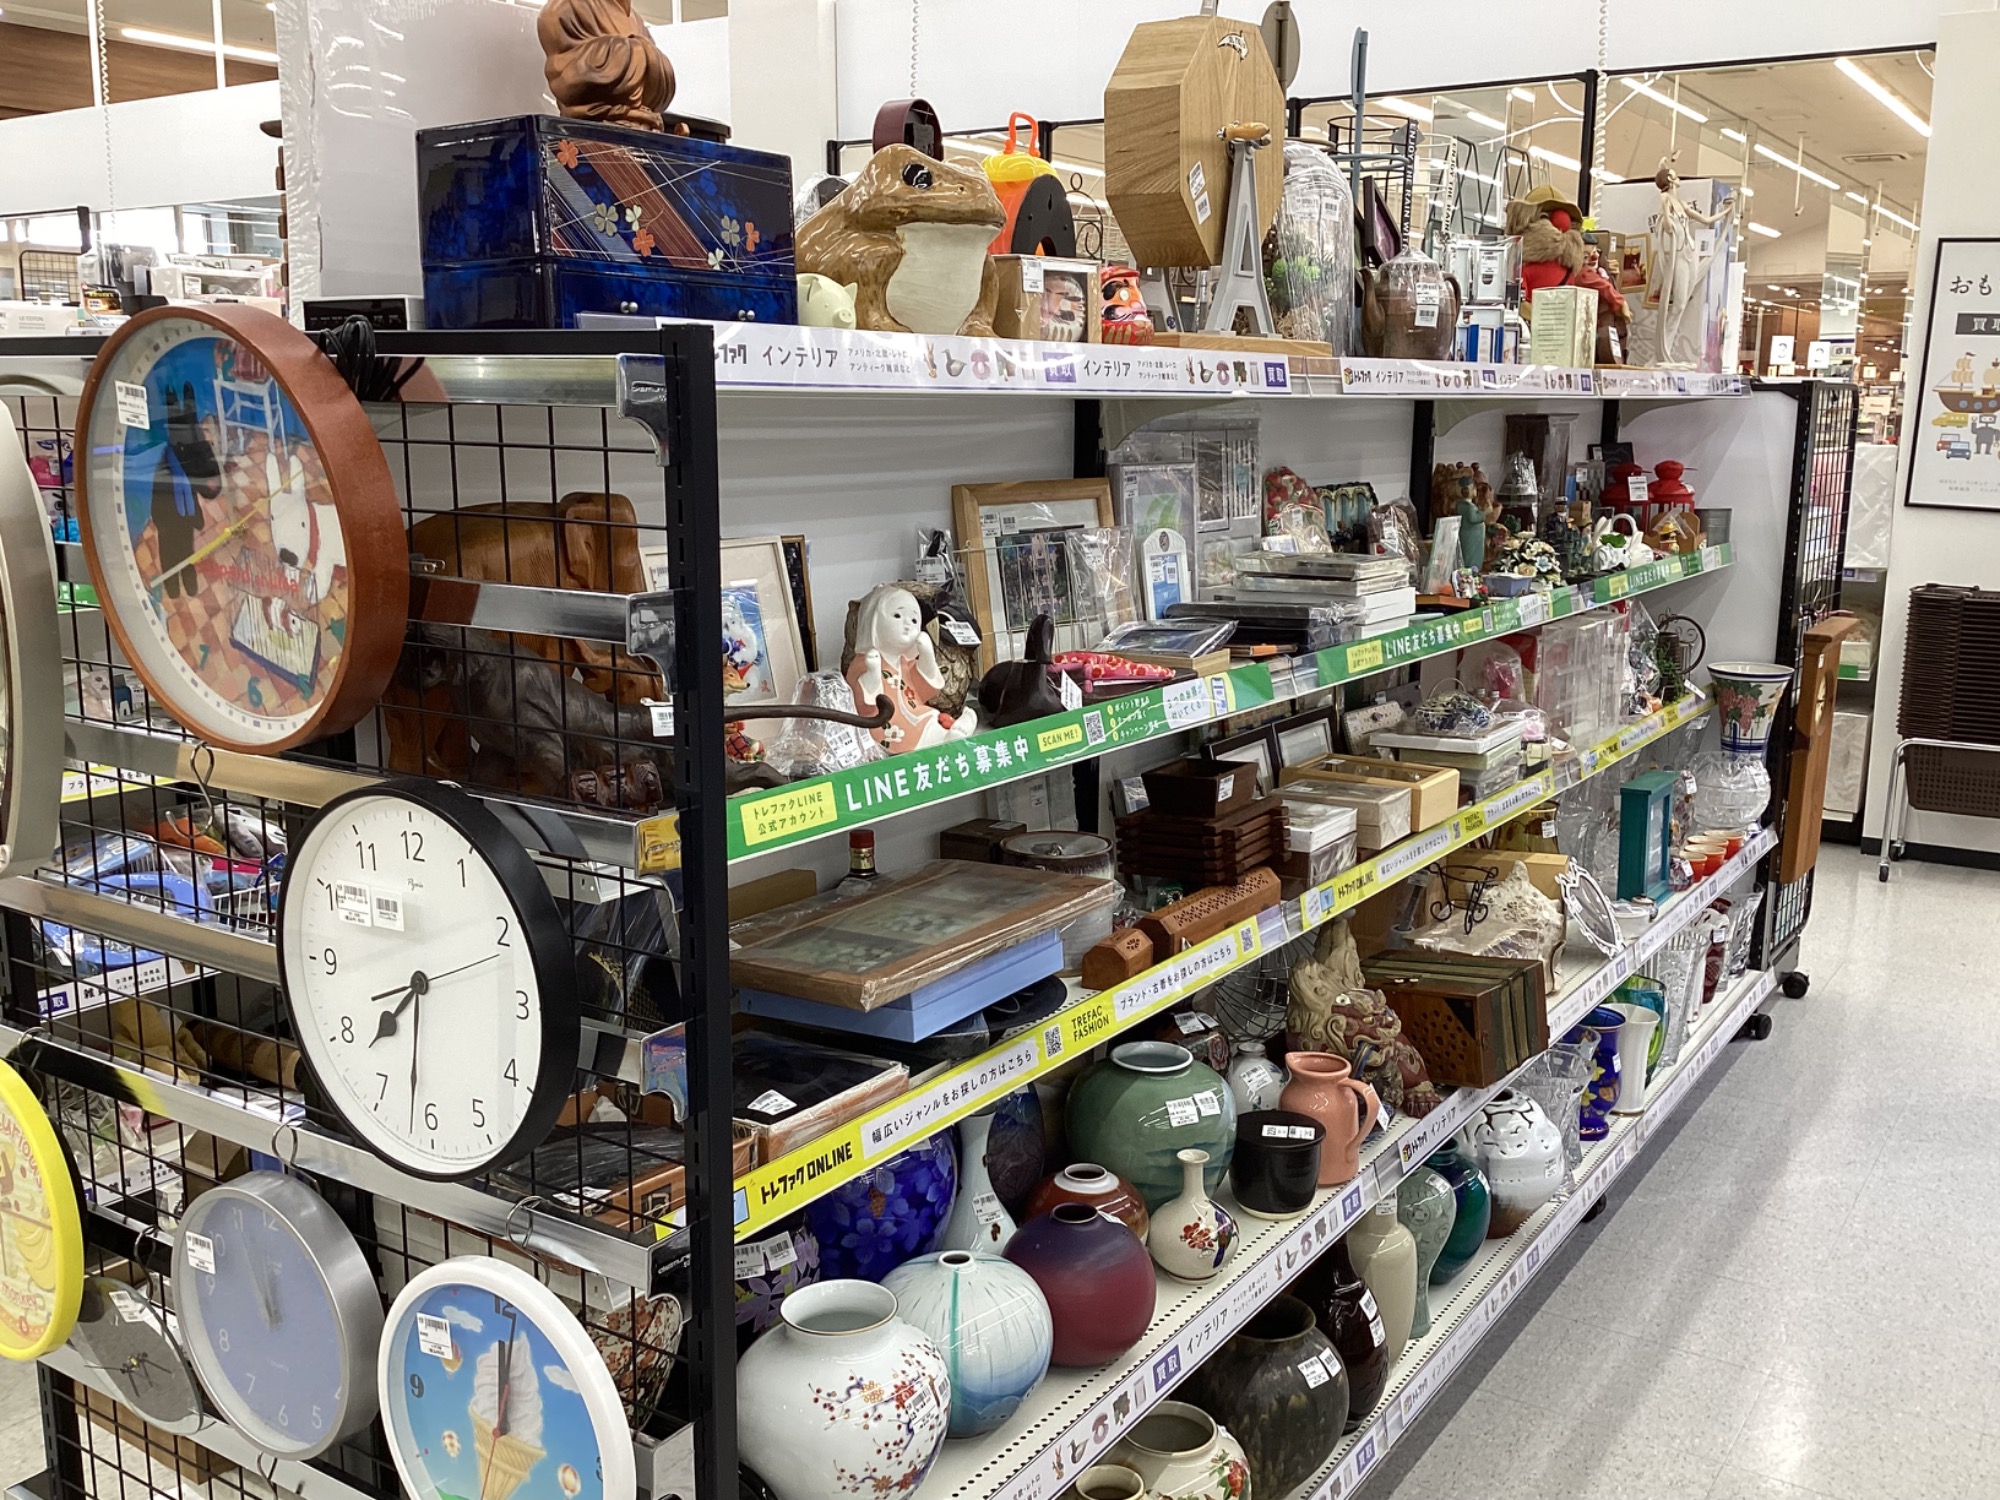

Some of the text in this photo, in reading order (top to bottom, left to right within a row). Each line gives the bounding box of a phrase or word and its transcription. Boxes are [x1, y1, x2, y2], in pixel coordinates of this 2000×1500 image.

[1407, 123, 1416, 160] ENJOY
[1402, 189, 1412, 218] RAIN
[714, 343, 838, 368] ファク インテリア
[1777, 342, 1788, 359] 3
[1083, 359, 1131, 378] インテリア
[1266, 366, 1286, 384] 買取
[200, 644, 211, 670] 7
[247, 676, 263, 708] 6
[1042, 728, 1079, 747] SCAN ME!
[845, 735, 1030, 812] LINE友だち募集中
[753, 791, 823, 820] トレファクLINE
[758, 807, 824, 836] 公式アカウント
[355, 841, 377, 871] 11
[400, 830, 426, 863] 12
[456, 858, 467, 888] 1
[325, 883, 338, 911] 1
[496, 916, 510, 947] 2
[323, 948, 338, 976] 9
[1120, 944, 1232, 1010] ブランド・古着をお探しの方はこちら
[516, 990, 530, 1020] 3
[1071, 1005, 1103, 1030] TREFAC
[340, 1016, 355, 1043] 8
[1073, 1017, 1110, 1042] FASHION
[376, 1072, 389, 1100] 7
[504, 1058, 520, 1087] 4
[872, 1050, 1032, 1143] 幅広いジャンルをお探しの方はこちら
[424, 1103, 438, 1131] 6
[472, 1098, 486, 1128] 5
[262, 1209, 279, 1232] 12
[206, 1275, 217, 1297] 9
[219, 1328, 230, 1352] 8
[1187, 1308, 1228, 1354] インテリア
[246, 1372, 256, 1394] 7
[1156, 1354, 1179, 1385] 買取
[409, 1373, 425, 1398] 9
[278, 1404, 289, 1426] 6
[312, 1404, 323, 1429] 5
